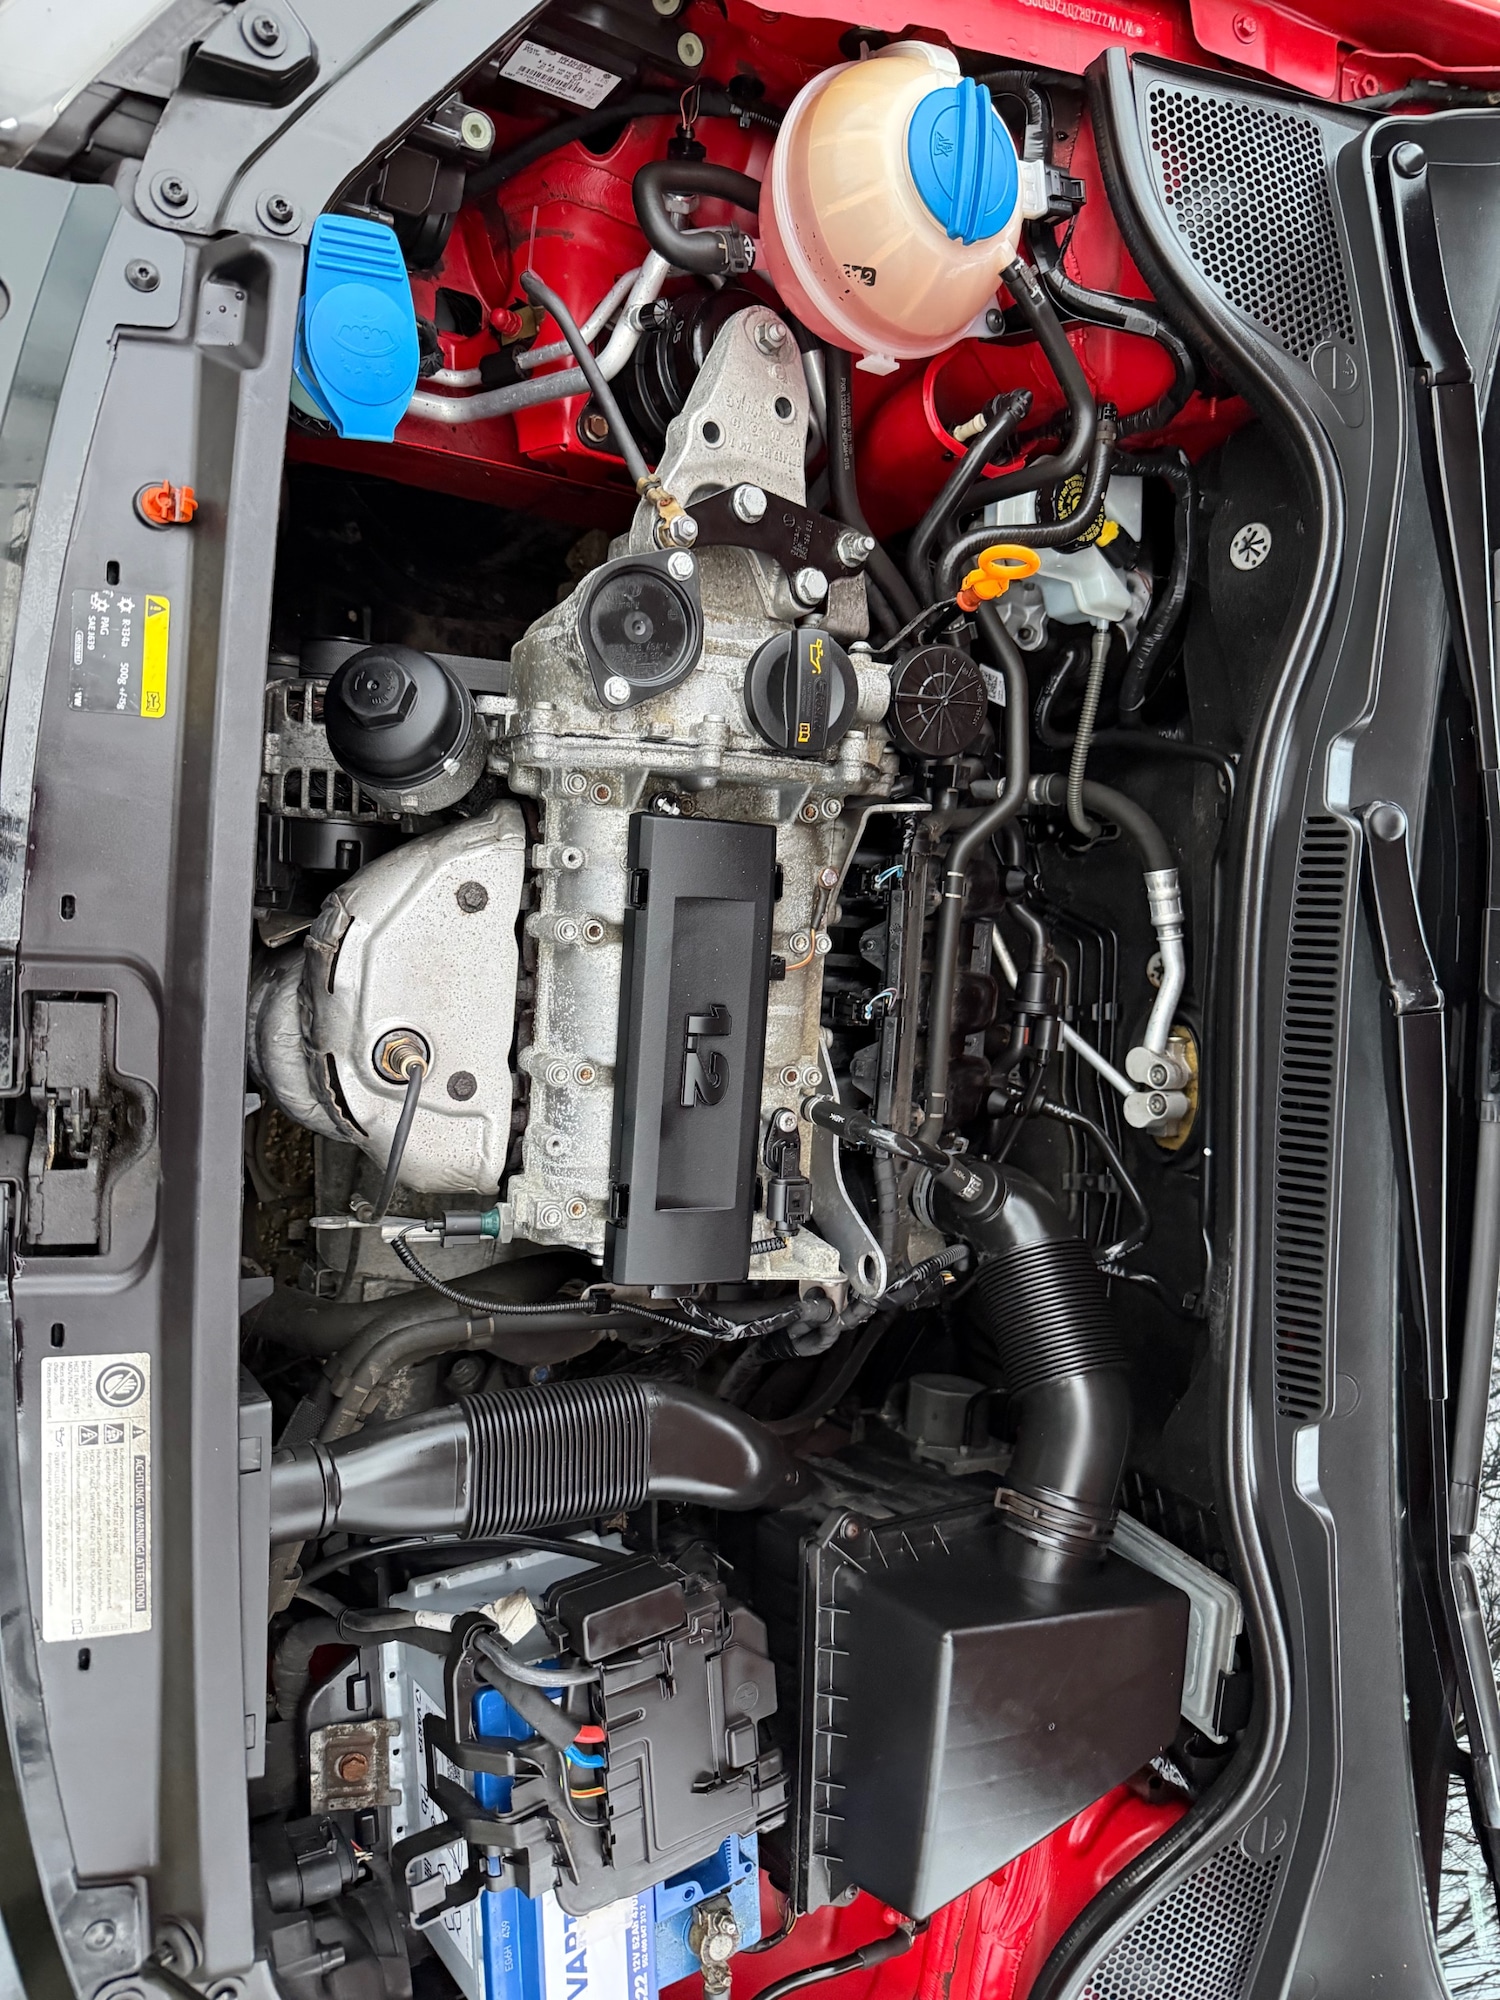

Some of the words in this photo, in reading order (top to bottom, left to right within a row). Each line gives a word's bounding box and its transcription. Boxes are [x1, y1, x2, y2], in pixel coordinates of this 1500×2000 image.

[88, 615, 97, 631] SAE
[99, 616, 110, 636] PAG
[121, 618, 131, 648] R-134a
[116, 662, 129, 686] 500g
[680, 1004, 733, 1108] 1.2
[135, 1458, 145, 1506] ACHTUNG!
[135, 1507, 145, 1555] WARNING!
[135, 1557, 145, 1609] ATTENTION!
[416, 1707, 424, 1754] VARTA
[501, 1920, 511, 1939] 439
[631, 1921, 641, 1950] 52Ah
[504, 1945, 514, 1972] EG6H
[563, 1911, 589, 2000] VART
[632, 1951, 641, 1973] 12V
[634, 1972, 649, 2000] 22
